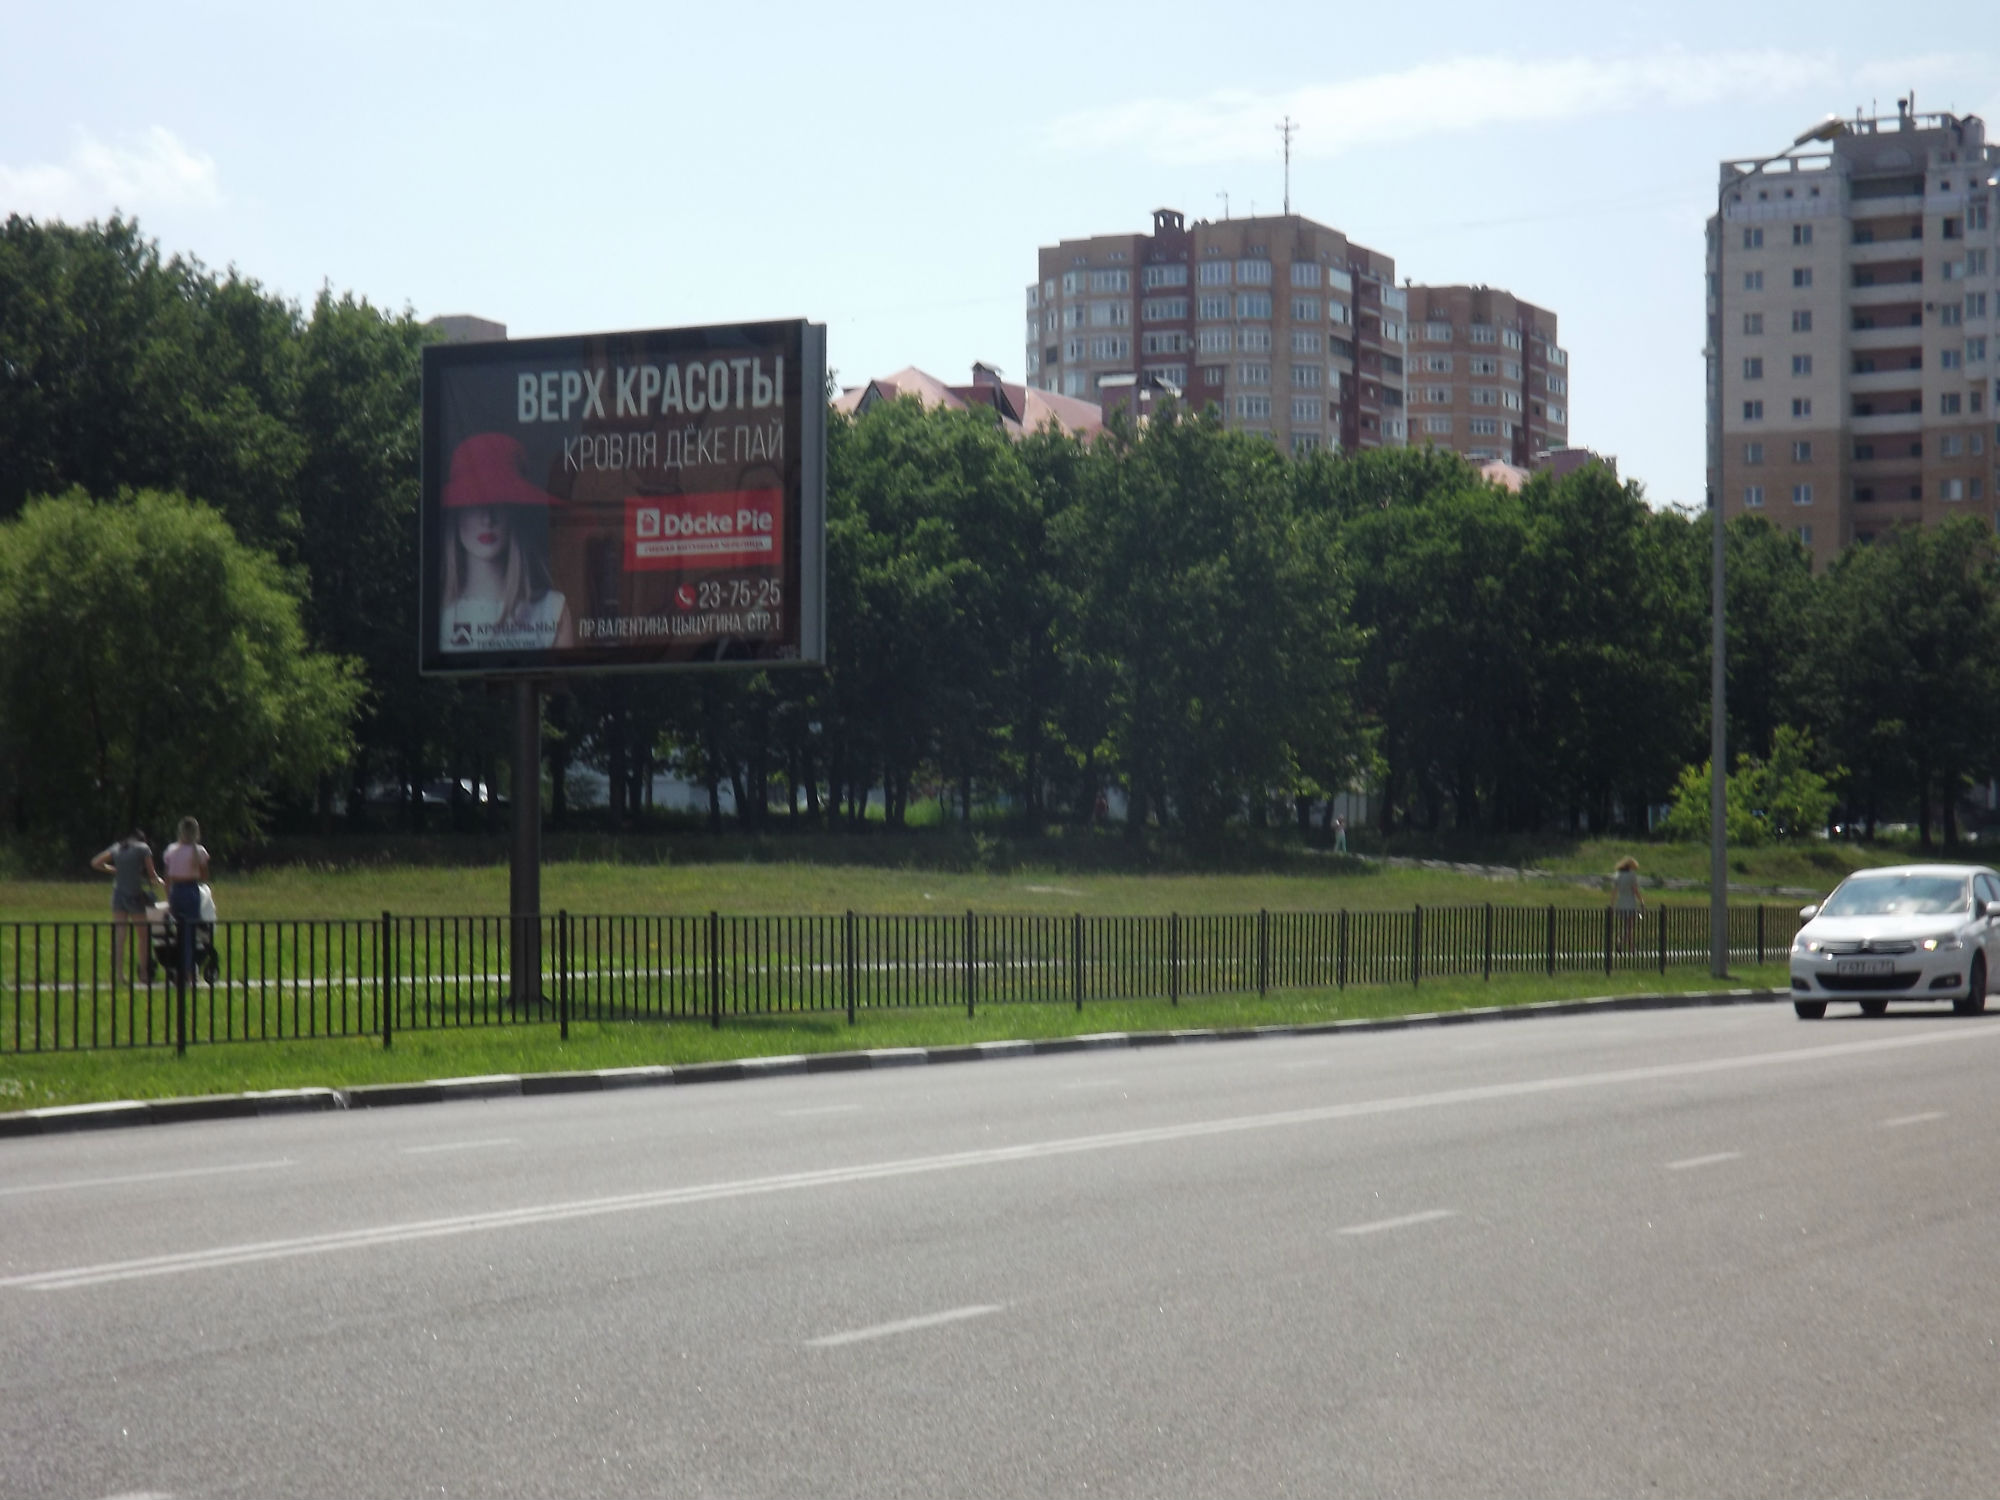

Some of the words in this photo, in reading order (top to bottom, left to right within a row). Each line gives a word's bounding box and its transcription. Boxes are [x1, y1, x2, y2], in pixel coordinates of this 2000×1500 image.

[517, 368, 605, 422] ВЕРХ
[616, 356, 784, 416] КРАСОТЫ
[564, 431, 657, 472] КРОВЛЯ
[663, 423, 728, 471] ДЁКЕ
[734, 418, 784, 463] ПАЙ
[663, 512, 733, 536] Döcke
[737, 508, 774, 532] Pie
[699, 579, 782, 608] 23-75-25
